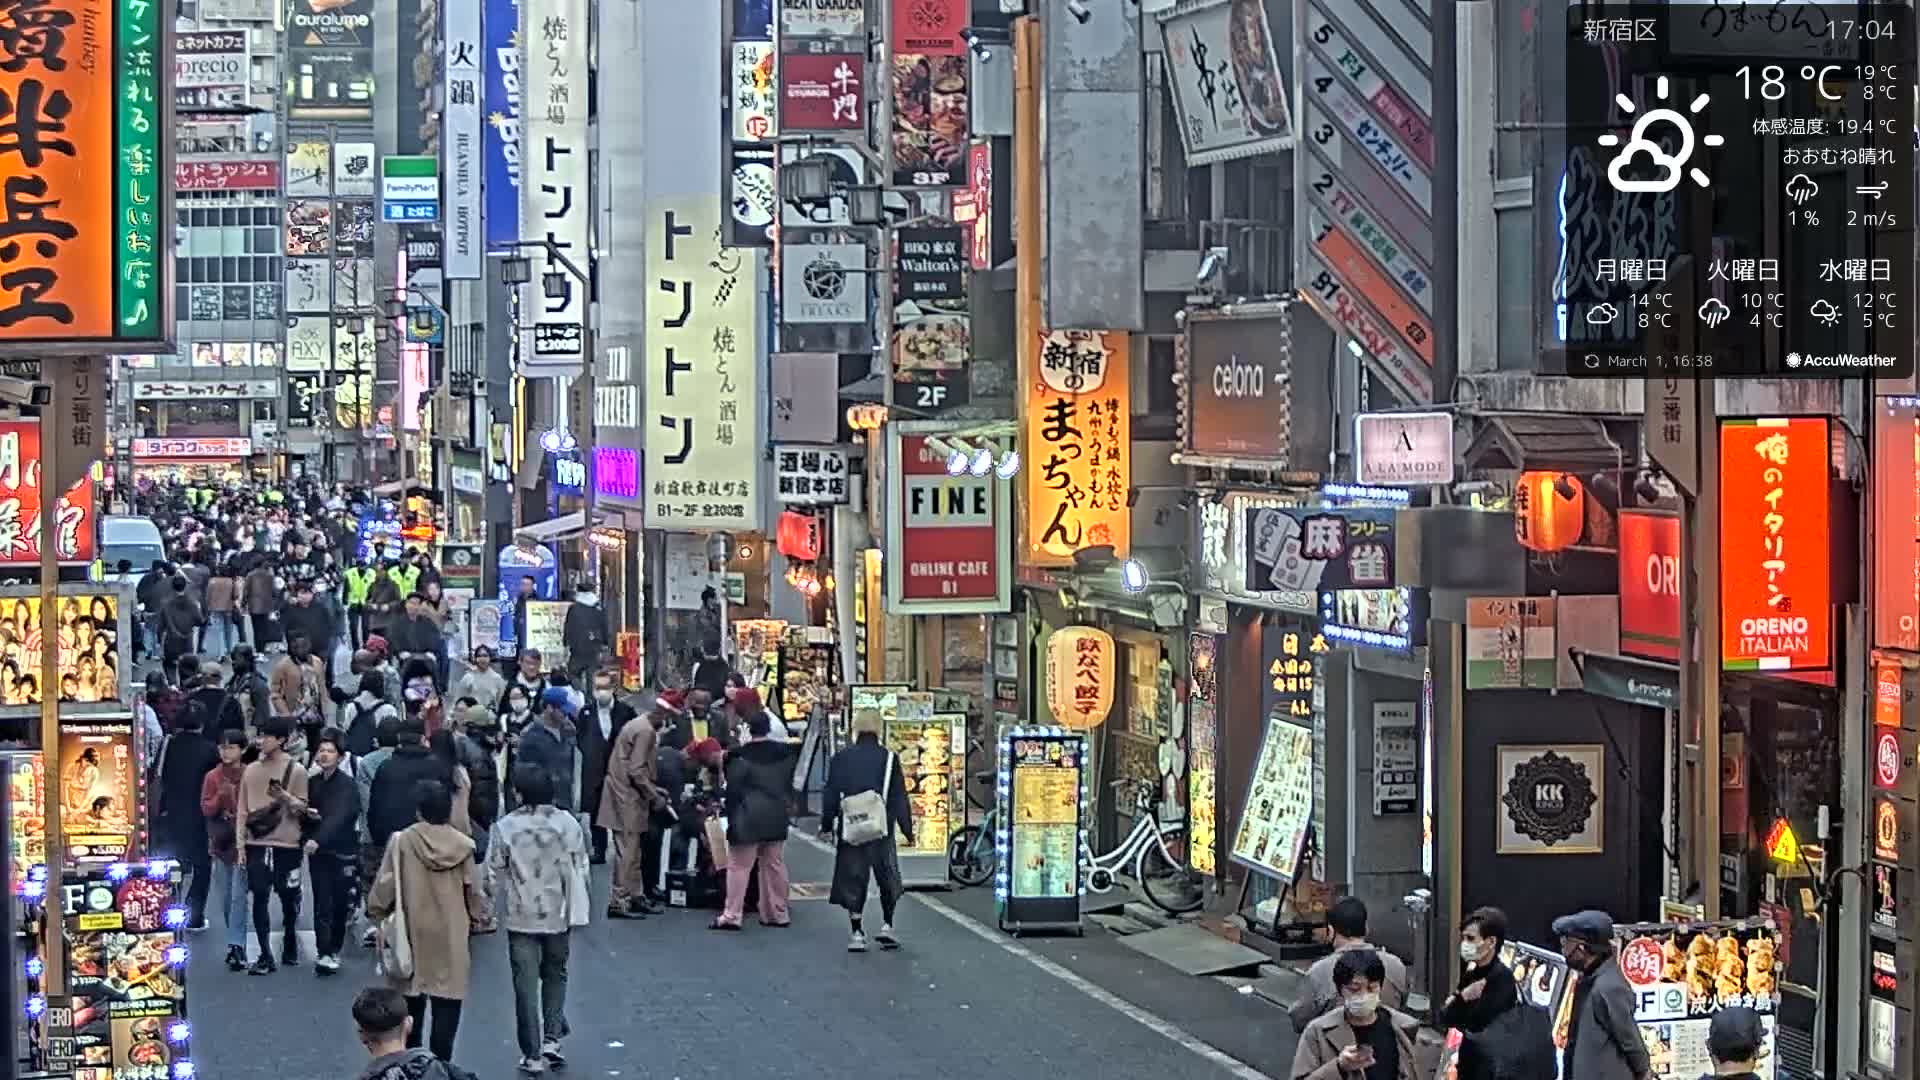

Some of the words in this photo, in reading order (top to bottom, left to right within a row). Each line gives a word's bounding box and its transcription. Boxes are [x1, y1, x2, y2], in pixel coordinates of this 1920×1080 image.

[1314, 24, 1334, 44] 5
[450, 42, 475, 106] 火鍋
[831, 61, 859, 122] 牛門
[1315, 77, 1334, 93] 4
[1315, 124, 1334, 144] 3
[1357, 119, 1412, 181] センチュリー
[387, 184, 435, 193] FamilyMart
[912, 172, 950, 185] 3F
[1313, 174, 1333, 194] 2
[457, 206, 468, 256] HOTPOT
[541, 136, 572, 313] トントン
[901, 258, 959, 273] Walton's
[660, 211, 692, 464] トントン
[713, 326, 738, 447] 焼とん酒場
[1213, 356, 1263, 397] celona
[917, 386, 947, 407] 2F
[779, 451, 844, 474] 酒場心
[1365, 463, 1373, 473] A
[1378, 463, 1396, 473] LA
[1402, 462, 1446, 473] MODE
[1041, 398, 1085, 548] まっちゃん
[779, 477, 844, 495] 新宿本店
[912, 487, 986, 515] FINE
[1351, 521, 1389, 536] フリー
[1754, 432, 1790, 607] 俺のイタリアン
[911, 563, 954, 577] ONLINE
[958, 561, 988, 576] CAFE
[1741, 616, 1807, 636] ORENO
[1741, 636, 1808, 654] ITALIAN
[1536, 784, 1564, 800] KK
